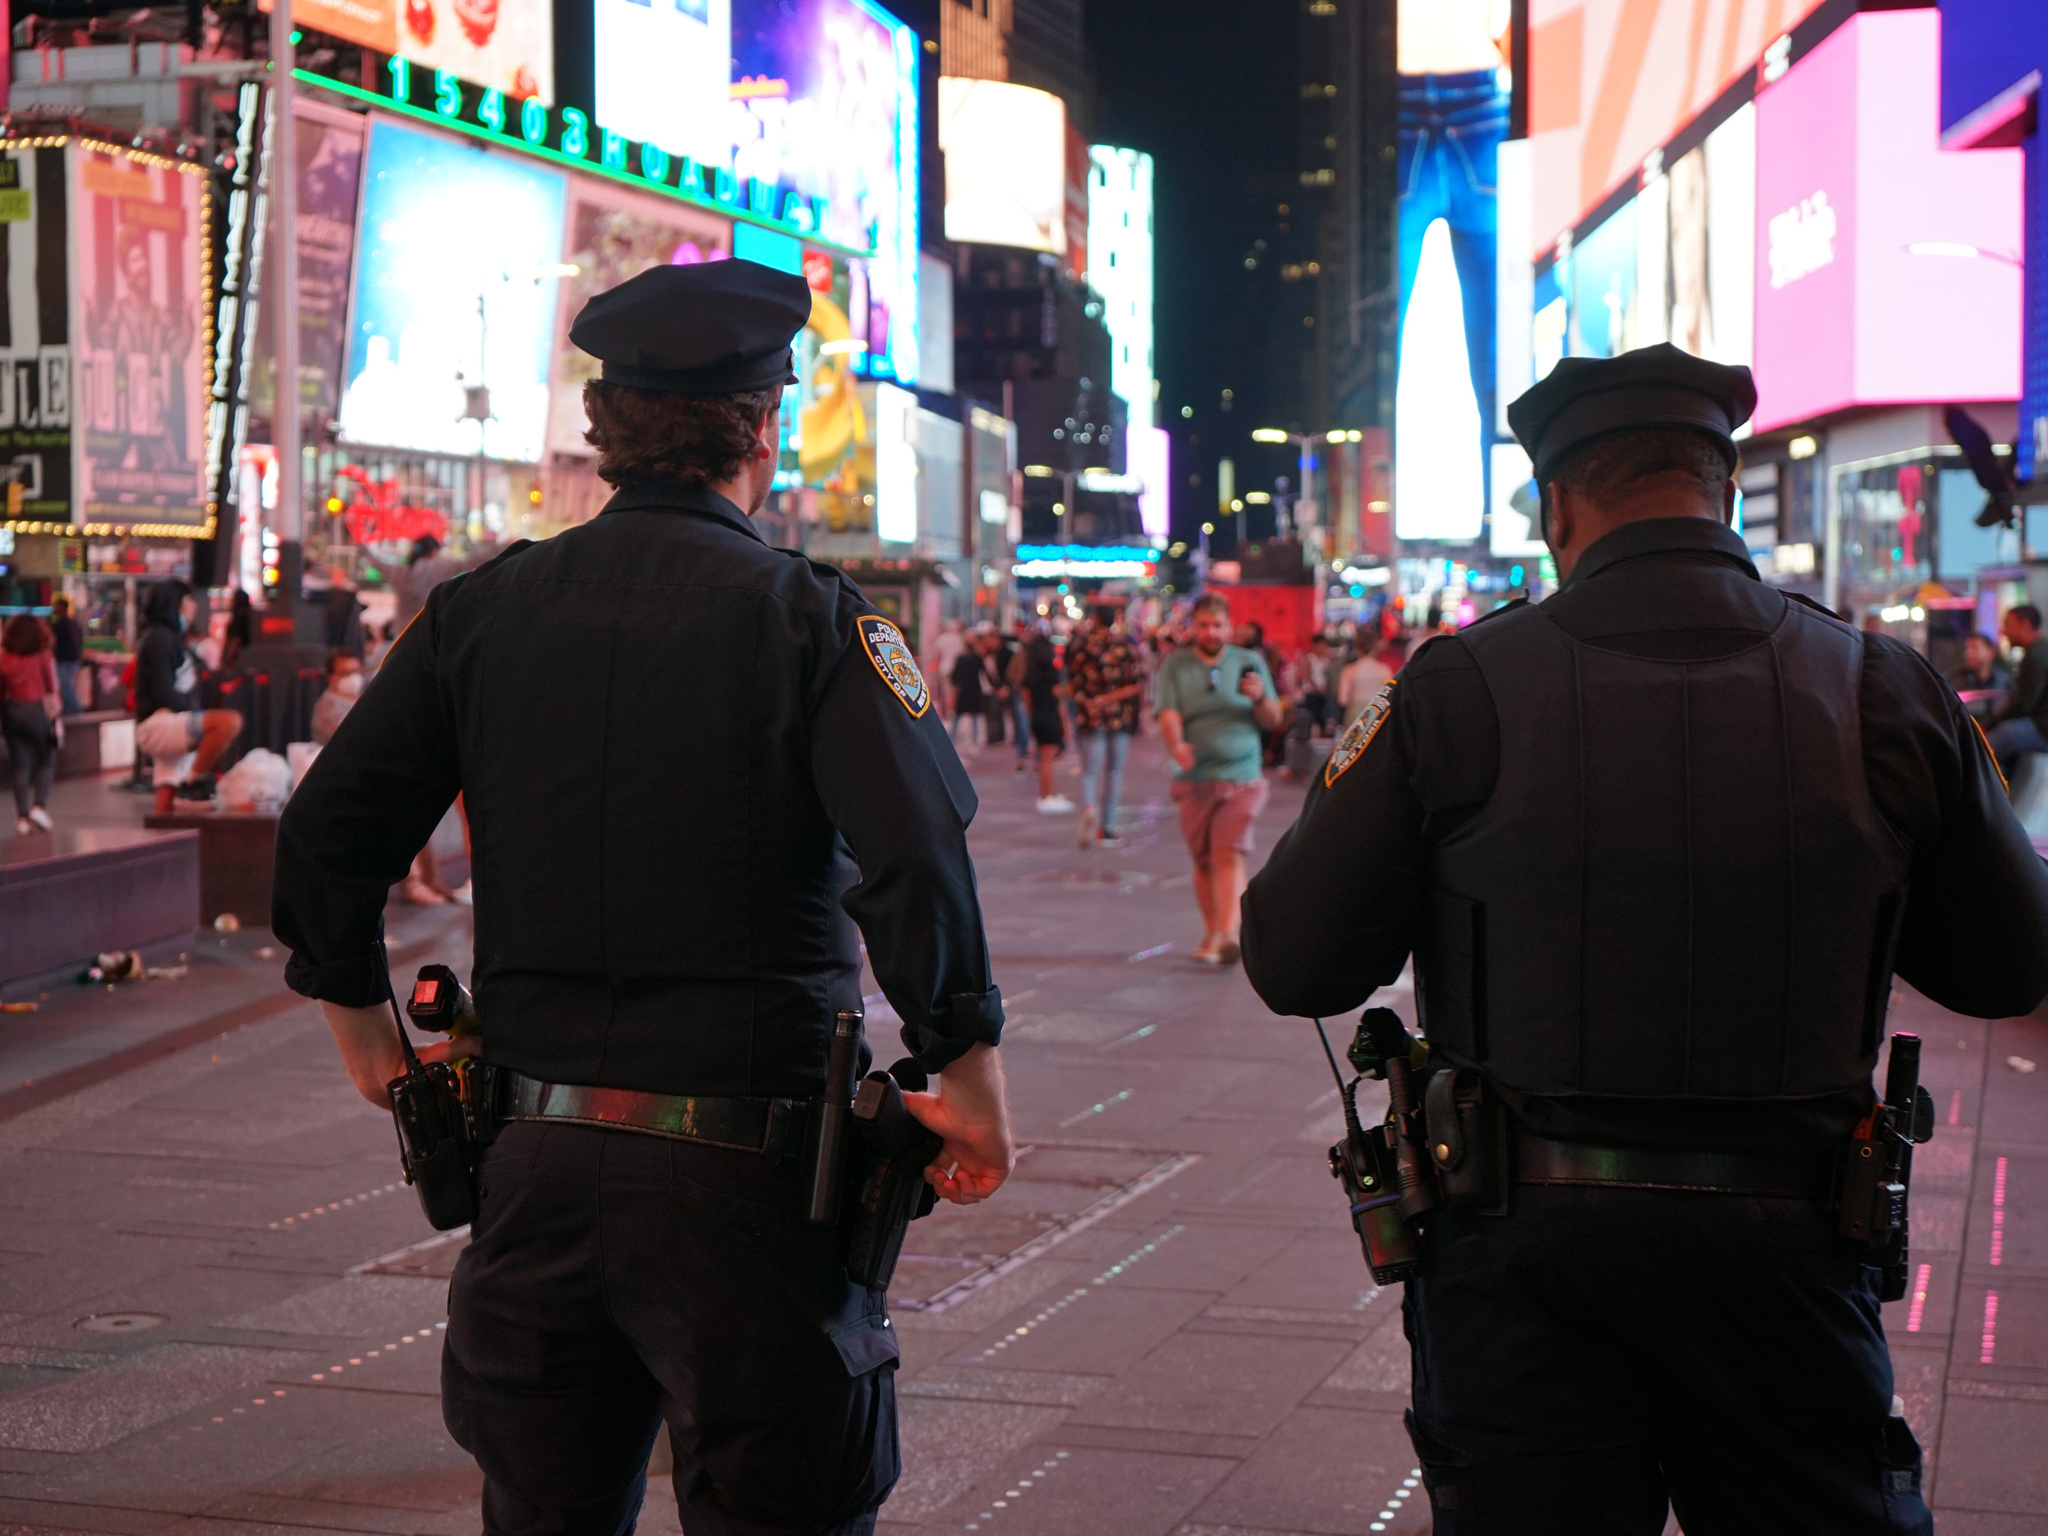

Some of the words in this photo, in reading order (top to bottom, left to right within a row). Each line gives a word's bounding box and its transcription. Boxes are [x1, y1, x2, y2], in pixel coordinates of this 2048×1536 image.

[388, 53, 547, 146] 1540
[874, 655, 895, 681] CITY
[893, 682, 907, 698] OF
[1355, 719, 1382, 750] YORK
